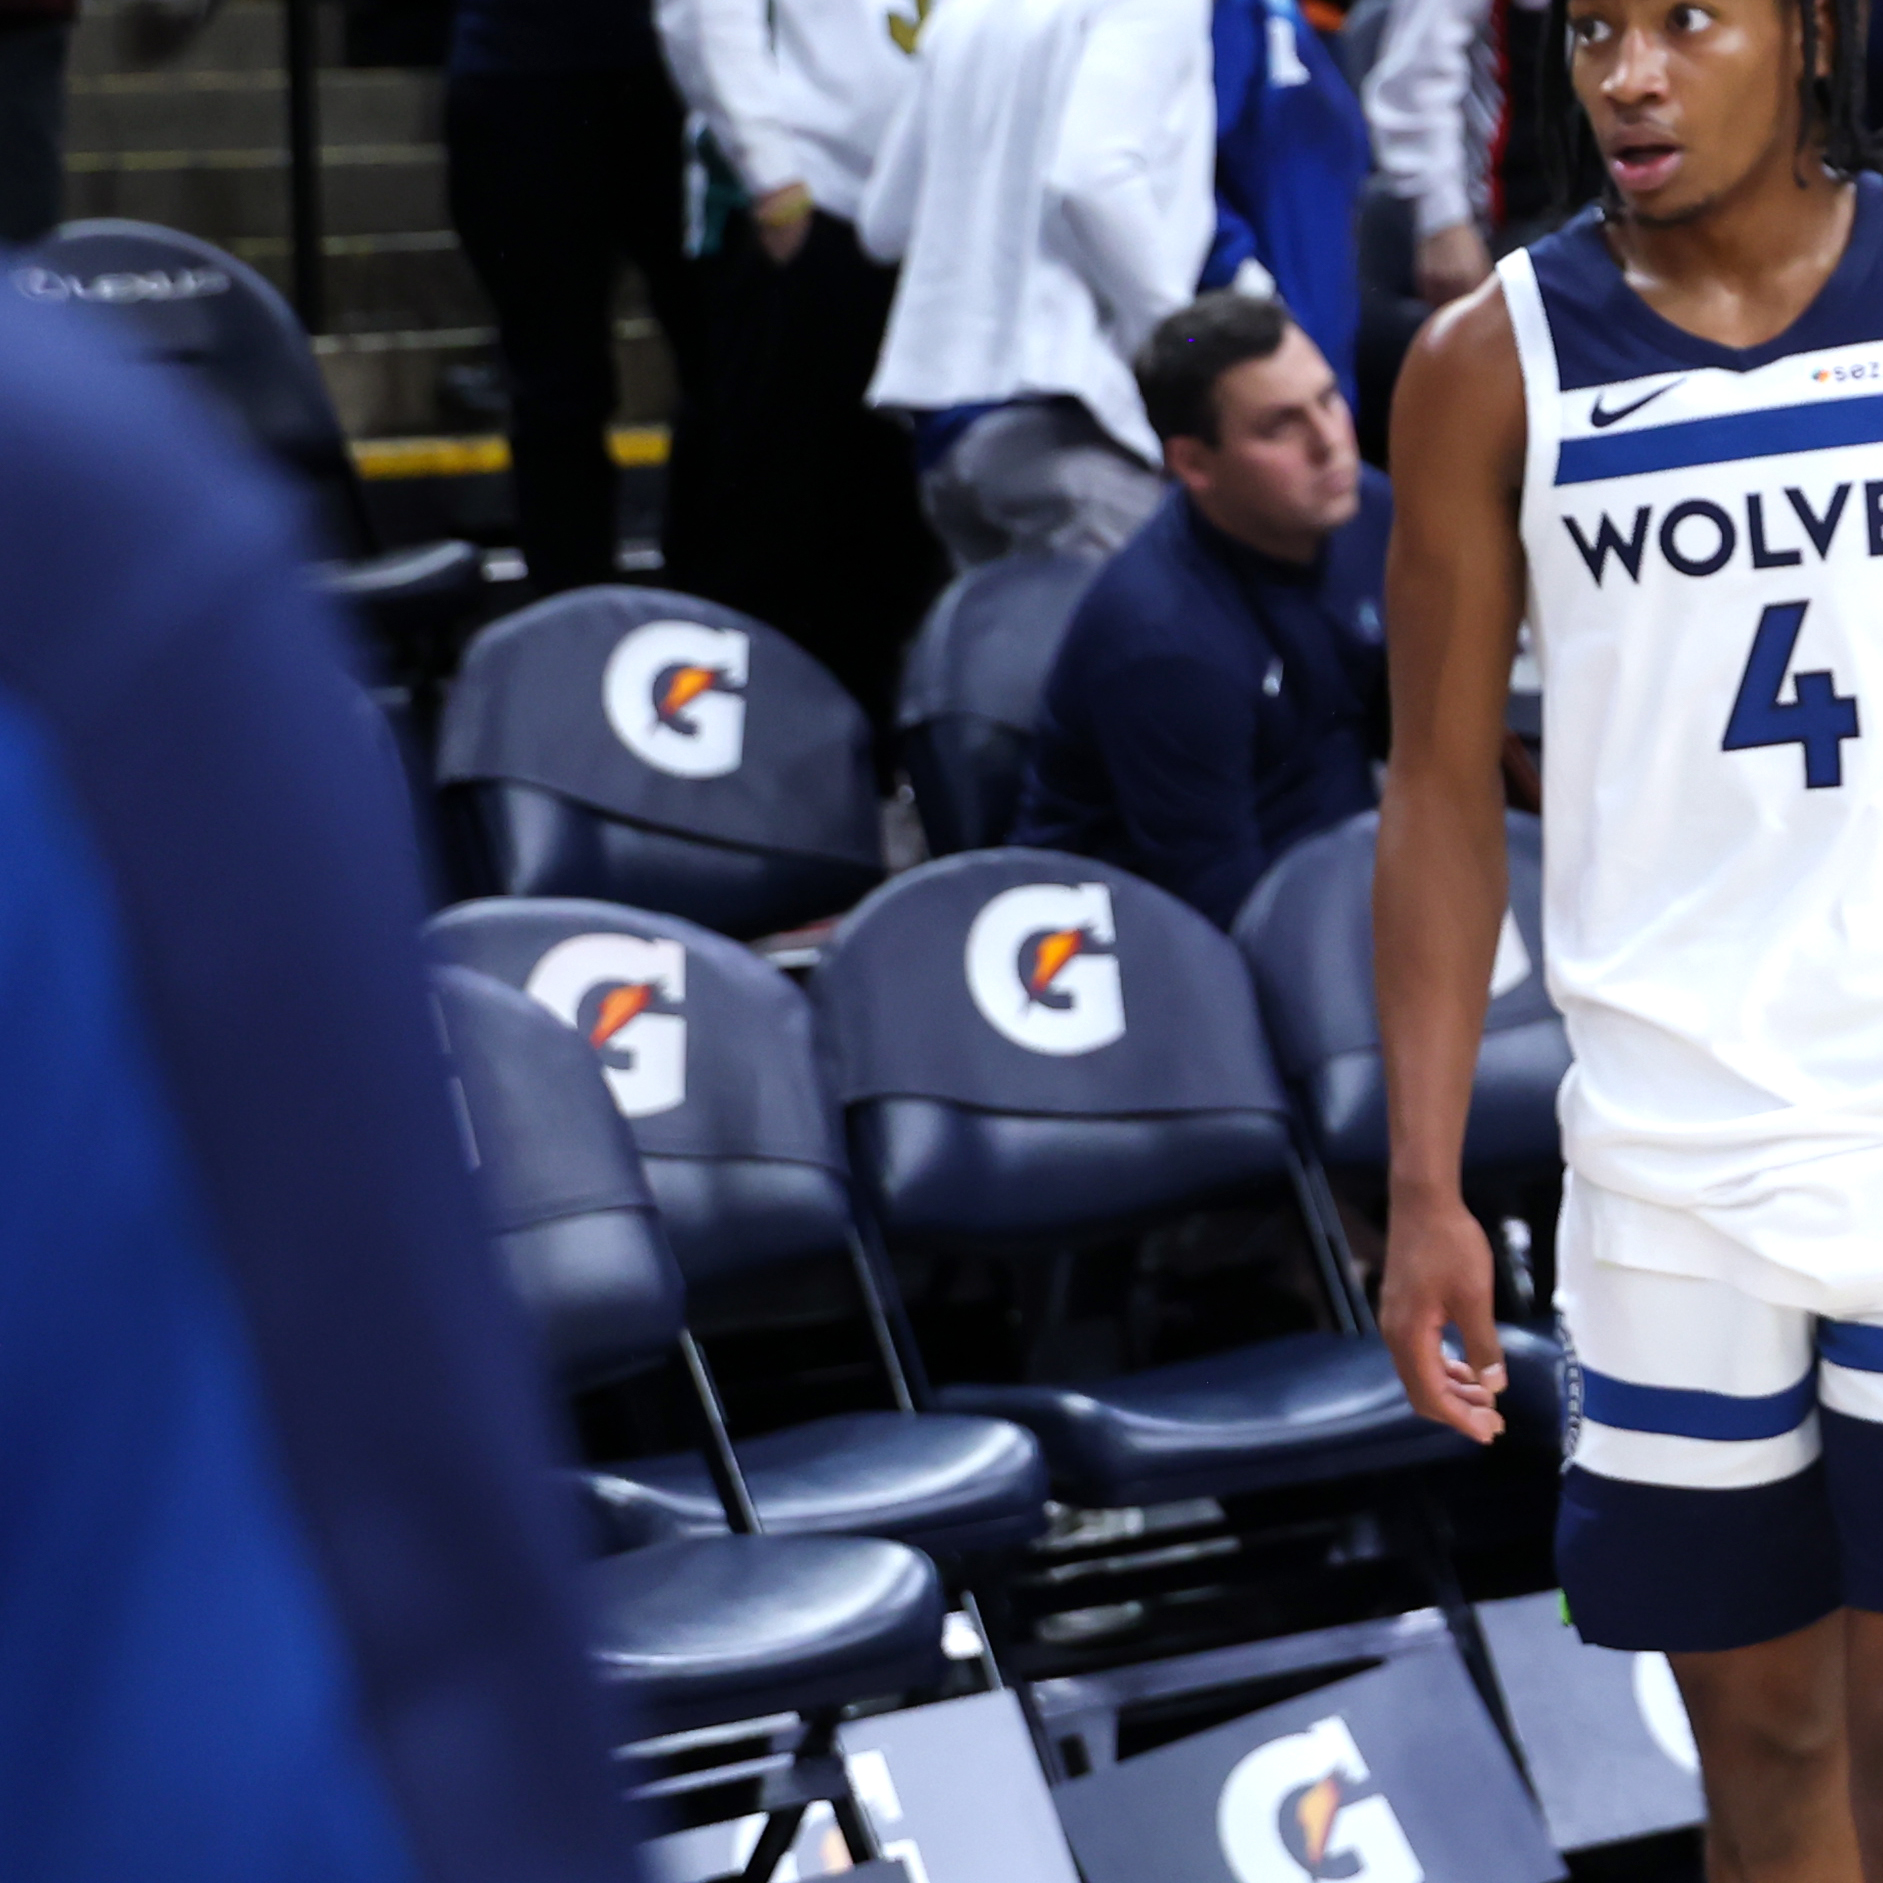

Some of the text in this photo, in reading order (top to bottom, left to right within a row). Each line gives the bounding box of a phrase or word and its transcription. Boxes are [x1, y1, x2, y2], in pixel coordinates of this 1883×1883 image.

[603, 619, 749, 779] G
[1722, 599, 1860, 789] 4
[965, 882, 1127, 1057] G
